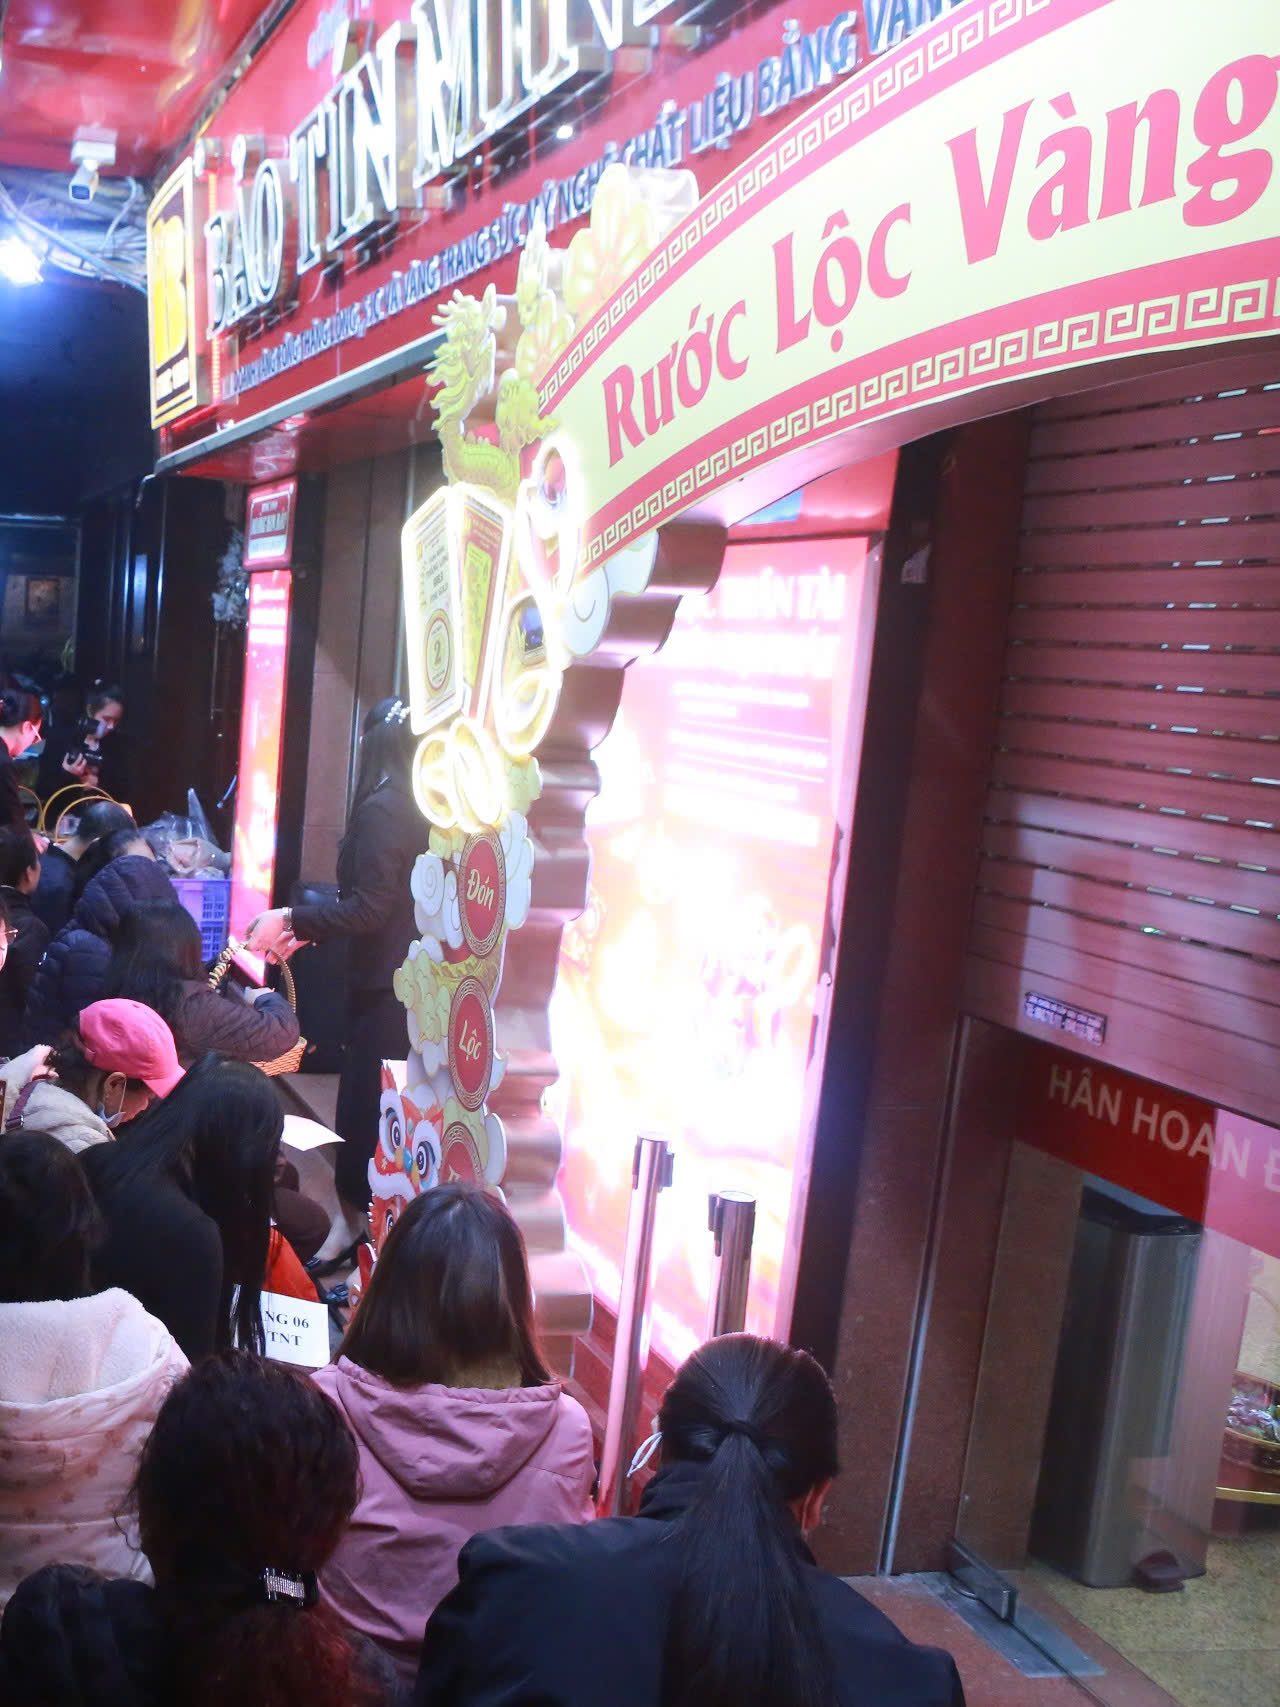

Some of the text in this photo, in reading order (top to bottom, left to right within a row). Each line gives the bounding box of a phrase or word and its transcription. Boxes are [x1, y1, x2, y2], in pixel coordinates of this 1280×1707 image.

[289, 18, 402, 276] TÍN
[439, 228, 491, 288] TRANG
[688, 71, 755, 154] LIỆU
[602, 53, 1280, 469] Rước Lộc Vàng
[466, 868, 494, 911] Đón
[458, 1019, 482, 1062] Lộc
[1048, 1063, 1122, 1127] HÂN
[1132, 1098, 1251, 1178] HOAN
[293, 1316, 310, 1329] 06
